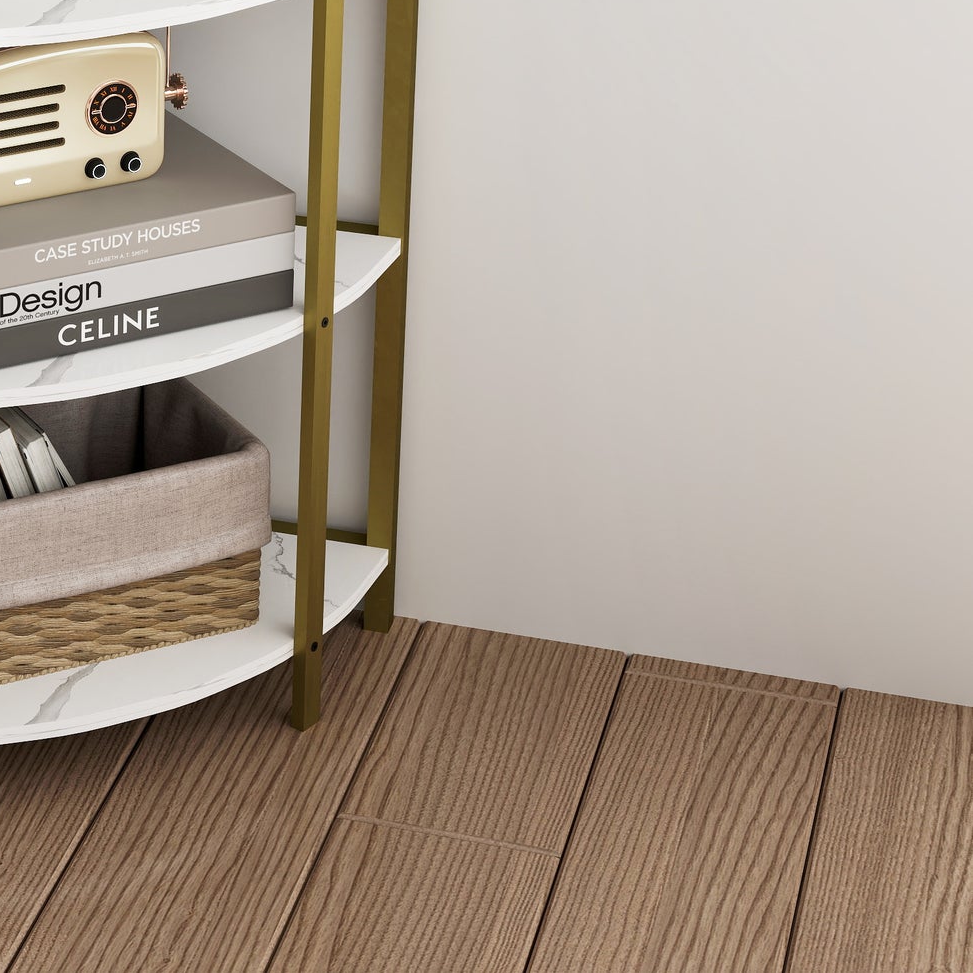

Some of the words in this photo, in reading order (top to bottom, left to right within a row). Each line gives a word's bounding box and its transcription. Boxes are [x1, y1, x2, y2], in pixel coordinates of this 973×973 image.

[34, 242, 78, 264] CASE
[80, 231, 133, 256] STUDY
[137, 218, 201, 244] HOUSES
[87, 255, 119, 266] ELIZABETH
[131, 248, 149, 257] SMITH
[0, 279, 103, 318] Design
[19, 314, 33, 322] 20th
[35, 308, 61, 319] Century
[57, 306, 160, 347] CELINE
